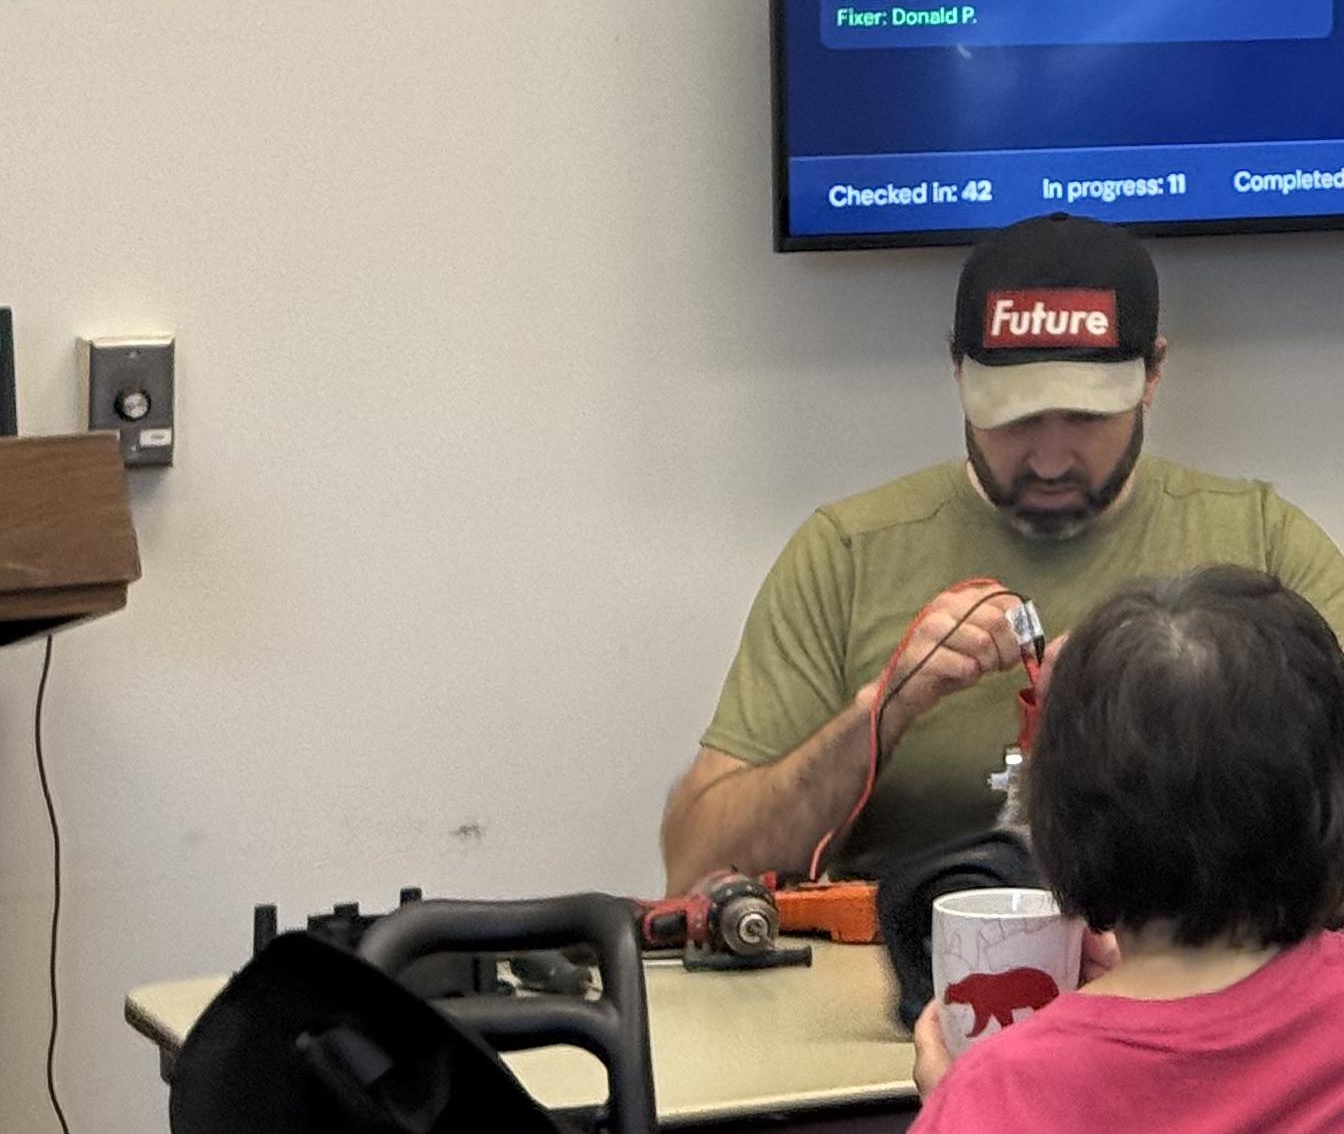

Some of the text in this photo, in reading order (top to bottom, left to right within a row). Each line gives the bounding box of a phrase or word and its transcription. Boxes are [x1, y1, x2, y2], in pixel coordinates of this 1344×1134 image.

[837, 8, 976, 26] Fixer: Donald P.
[829, 181, 992, 207] Checked in: 42
[1043, 174, 1185, 202] In progress: 11
[991, 300, 1108, 336] Future
